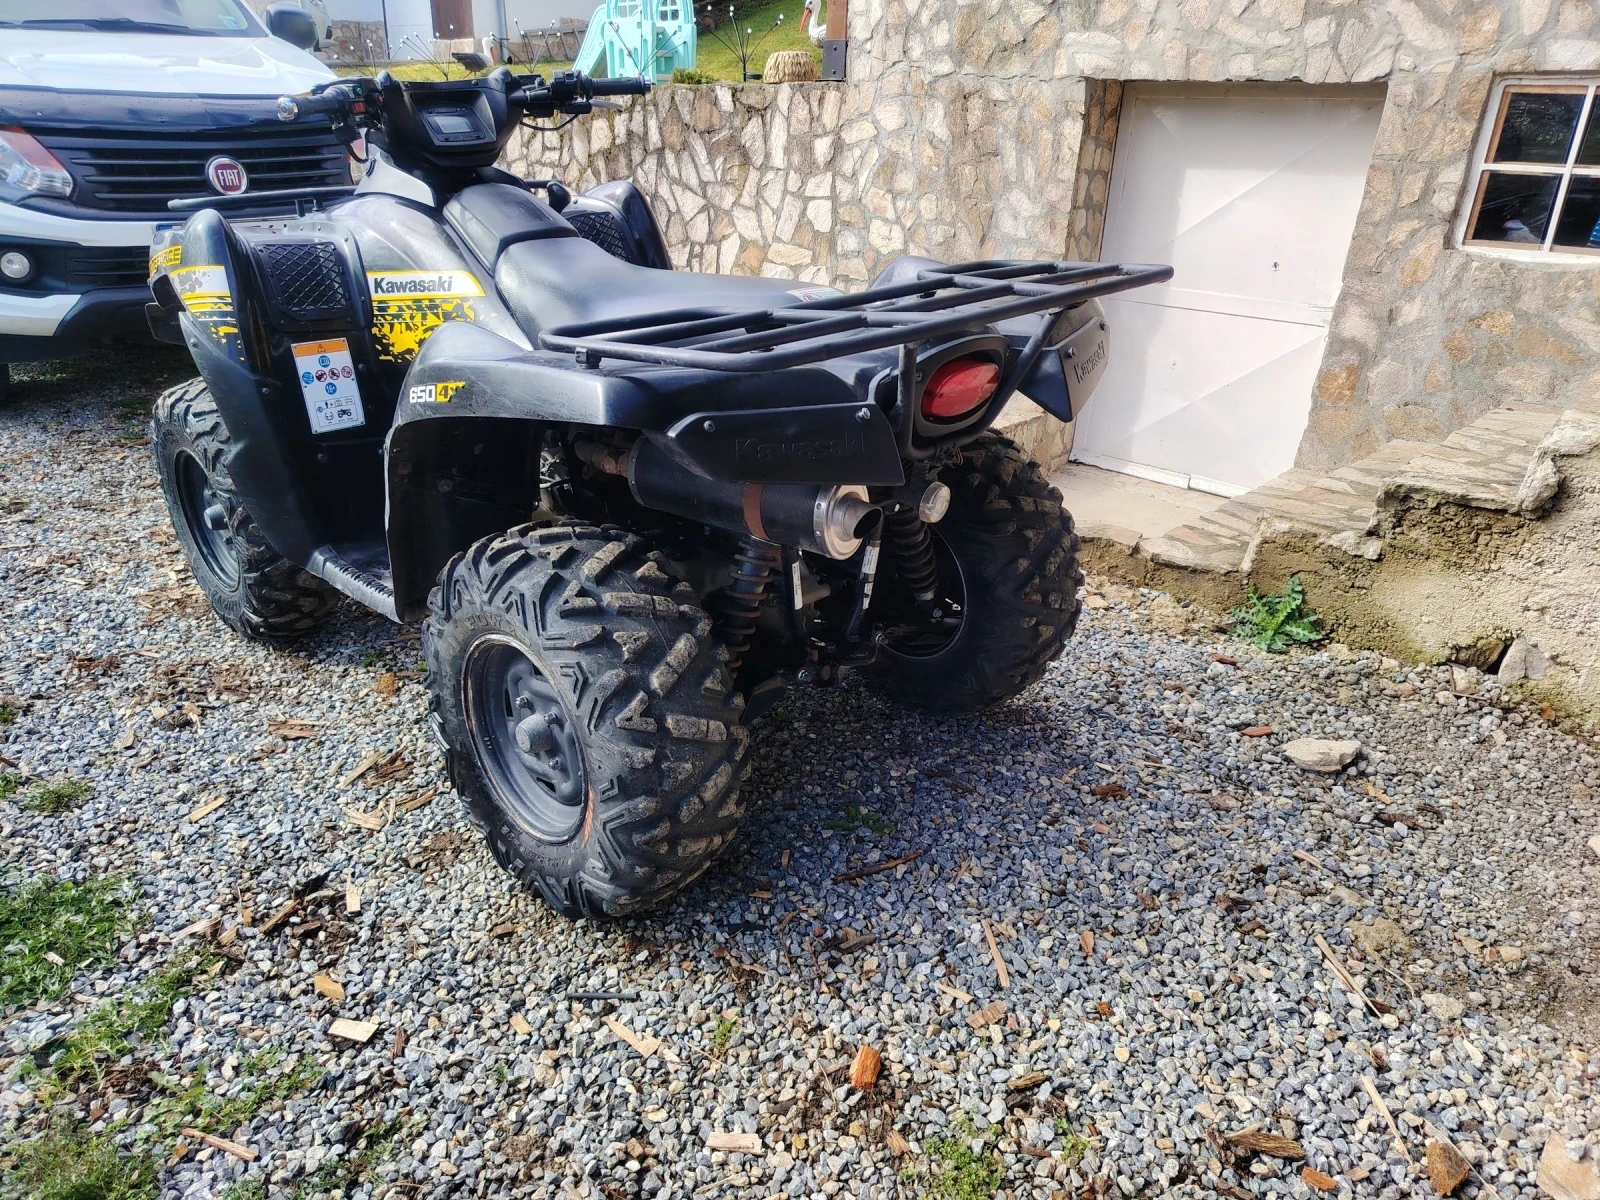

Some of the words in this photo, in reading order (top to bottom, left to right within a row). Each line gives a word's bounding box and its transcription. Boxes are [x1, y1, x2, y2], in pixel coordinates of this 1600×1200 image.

[217, 169, 240, 187] FIAT
[373, 275, 454, 295] Kawasaki
[1073, 340, 1106, 384] Kawasaki
[409, 385, 436, 403] 650
[735, 431, 866, 463] Kawasaki
